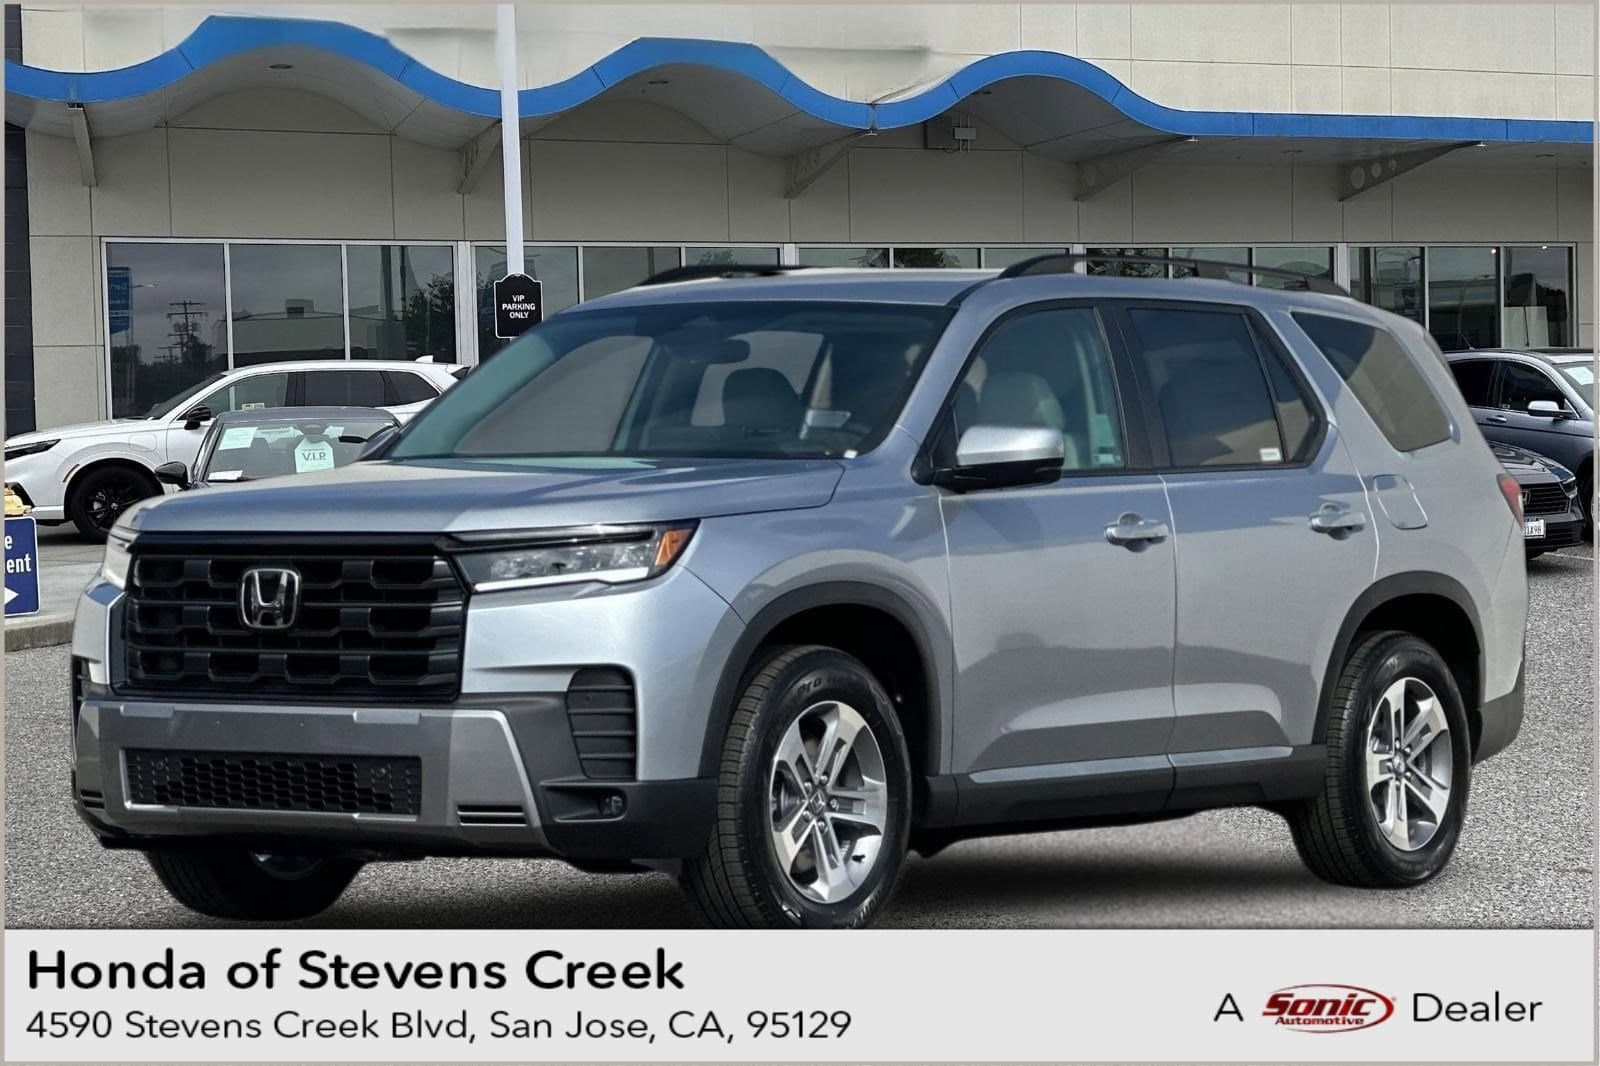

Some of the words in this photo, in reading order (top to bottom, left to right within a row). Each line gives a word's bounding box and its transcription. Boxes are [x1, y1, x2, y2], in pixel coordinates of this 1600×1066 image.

[512, 294, 525, 302] VIP
[509, 311, 529, 319] ONLY
[7, 553, 32, 573] ent
